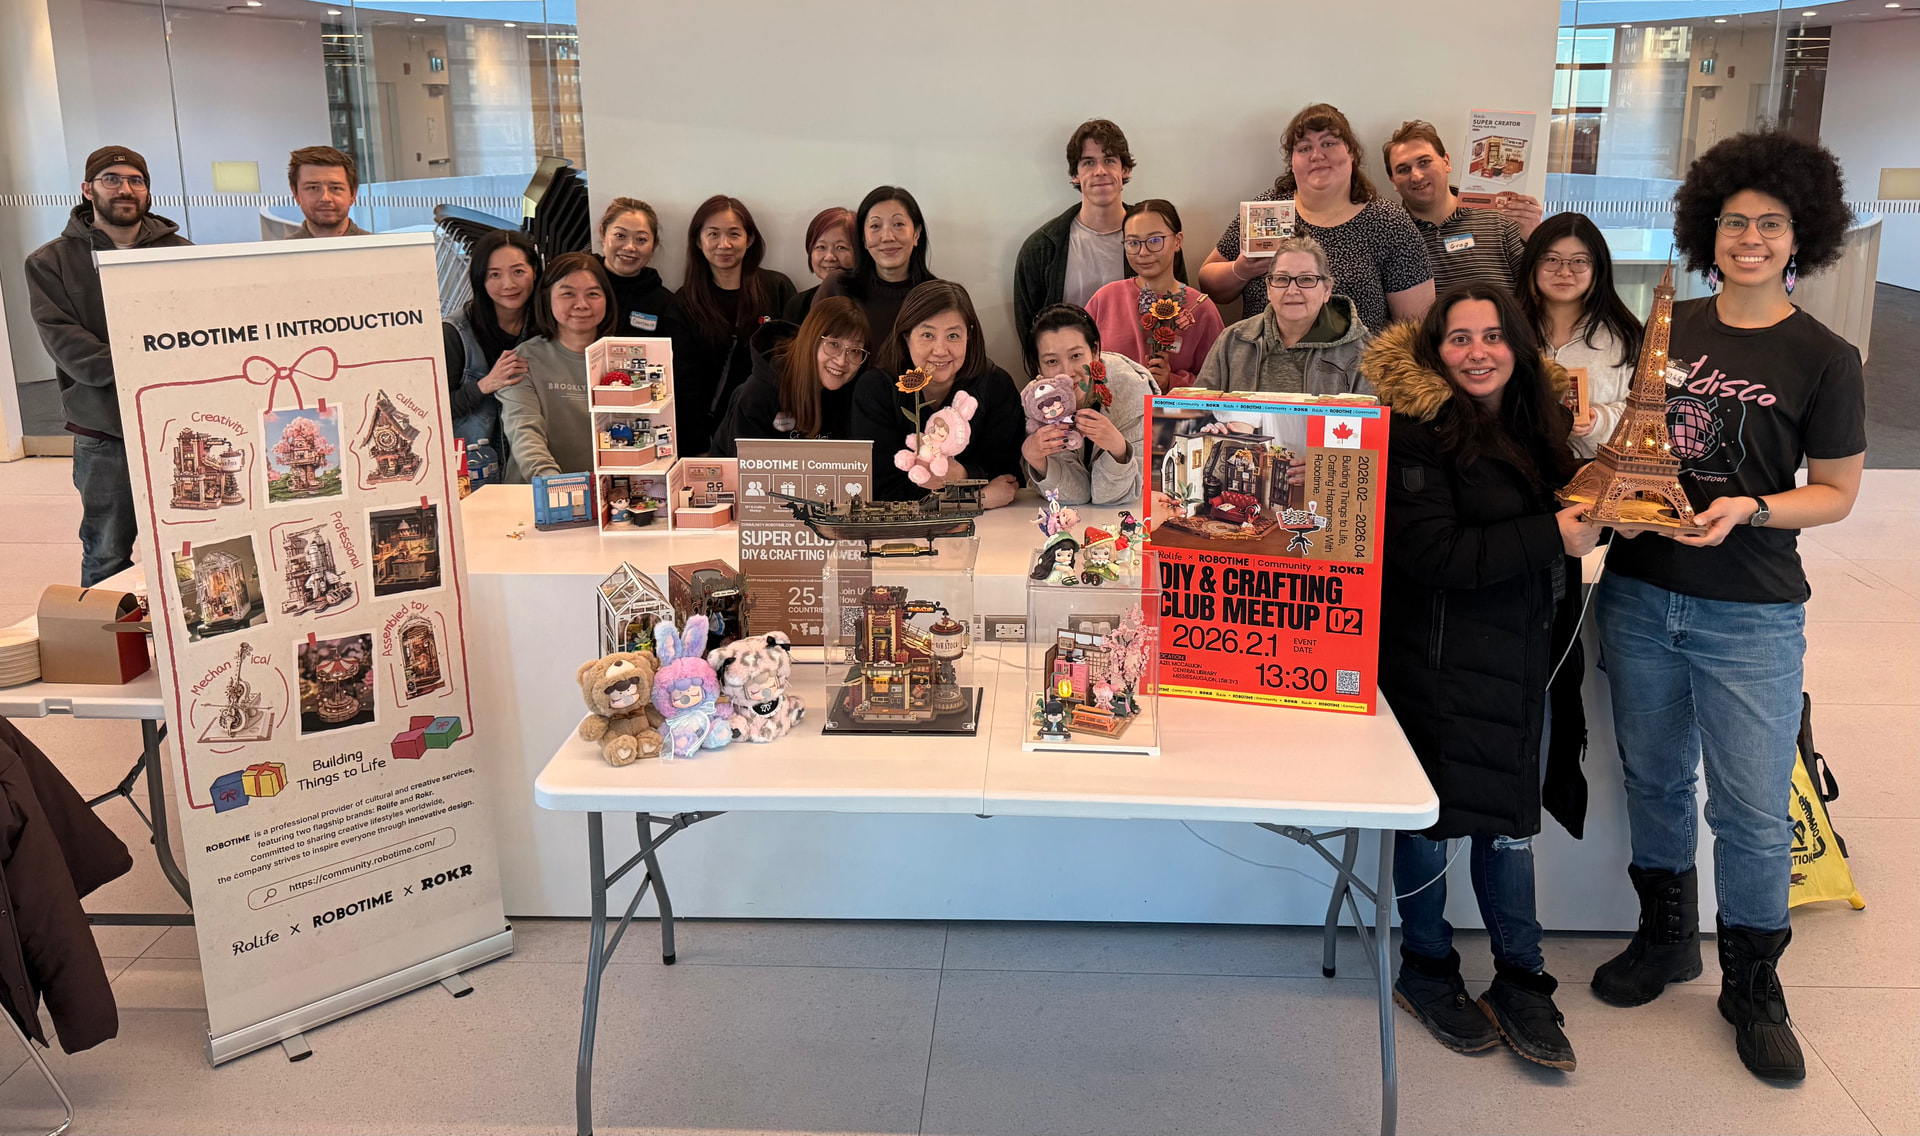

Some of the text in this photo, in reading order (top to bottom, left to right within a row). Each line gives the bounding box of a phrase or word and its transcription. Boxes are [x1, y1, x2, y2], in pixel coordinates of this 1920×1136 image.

[143, 324, 259, 352] ROBOTIME
[277, 309, 423, 338] INTRODUCTION
[548, 382, 587, 391] BROOKLY
[1688, 370, 1776, 406] disco
[396, 392, 429, 420] cultural
[192, 412, 248, 436] Creativity
[740, 460, 798, 470] ROBOTIME
[807, 460, 868, 472] Community
[1339, 456, 1351, 488] Building
[1324, 454, 1337, 553] Crafting Happiness With
[1338, 490, 1350, 518] Things
[330, 511, 364, 570] Professional
[742, 531, 792, 546] SUPER
[742, 549, 759, 560] DIY
[769, 549, 824, 560] CRAFTING
[827, 549, 868, 560] LOVER
[1158, 550, 1183, 560] Rolife
[1199, 554, 1249, 566] ROBOTIME
[1258, 560, 1311, 572] Community
[1330, 565, 1364, 575] ROKR
[788, 587, 830, 605] 25+
[1160, 562, 1342, 604] DIY & CRAFTING
[382, 600, 429, 656] Assembled toy
[1160, 592, 1360, 634] CLUB MEETUP 02
[1173, 624, 1277, 657] 2026.2.1
[1294, 638, 1317, 646] EVENT
[1255, 663, 1327, 692] 13:30
[296, 758, 386, 790] Things to Life
[313, 751, 363, 771] Building
[206, 834, 250, 853] ROBOTIME
[270, 812, 319, 834] professional
[321, 802, 354, 819] provider
[365, 790, 393, 804] cultural
[395, 786, 409, 795] and
[410, 777, 441, 790] creative
[442, 767, 475, 781] services,
[257, 790, 434, 848] featuring two flagship brands: Rolife and Rokr.
[218, 875, 232, 884] the
[234, 862, 272, 880] company
[274, 854, 301, 866] strives
[312, 842, 339, 855] inspire
[341, 830, 376, 846] everyone
[377, 820, 407, 834] through
[408, 808, 446, 824] innovative
[448, 800, 475, 812] design.
[250, 842, 295, 862] Committed
[306, 830, 336, 845] sharing
[338, 822, 369, 835] creative
[370, 811, 404, 825] lifestyles
[405, 798, 445, 814] worldwide,
[289, 838, 436, 892] https://community.robotime.com/
[1791, 852, 1814, 866] TION
[232, 929, 280, 956] Rolife
[312, 890, 394, 928] ROBOTIME
[420, 864, 472, 891] ROKR
